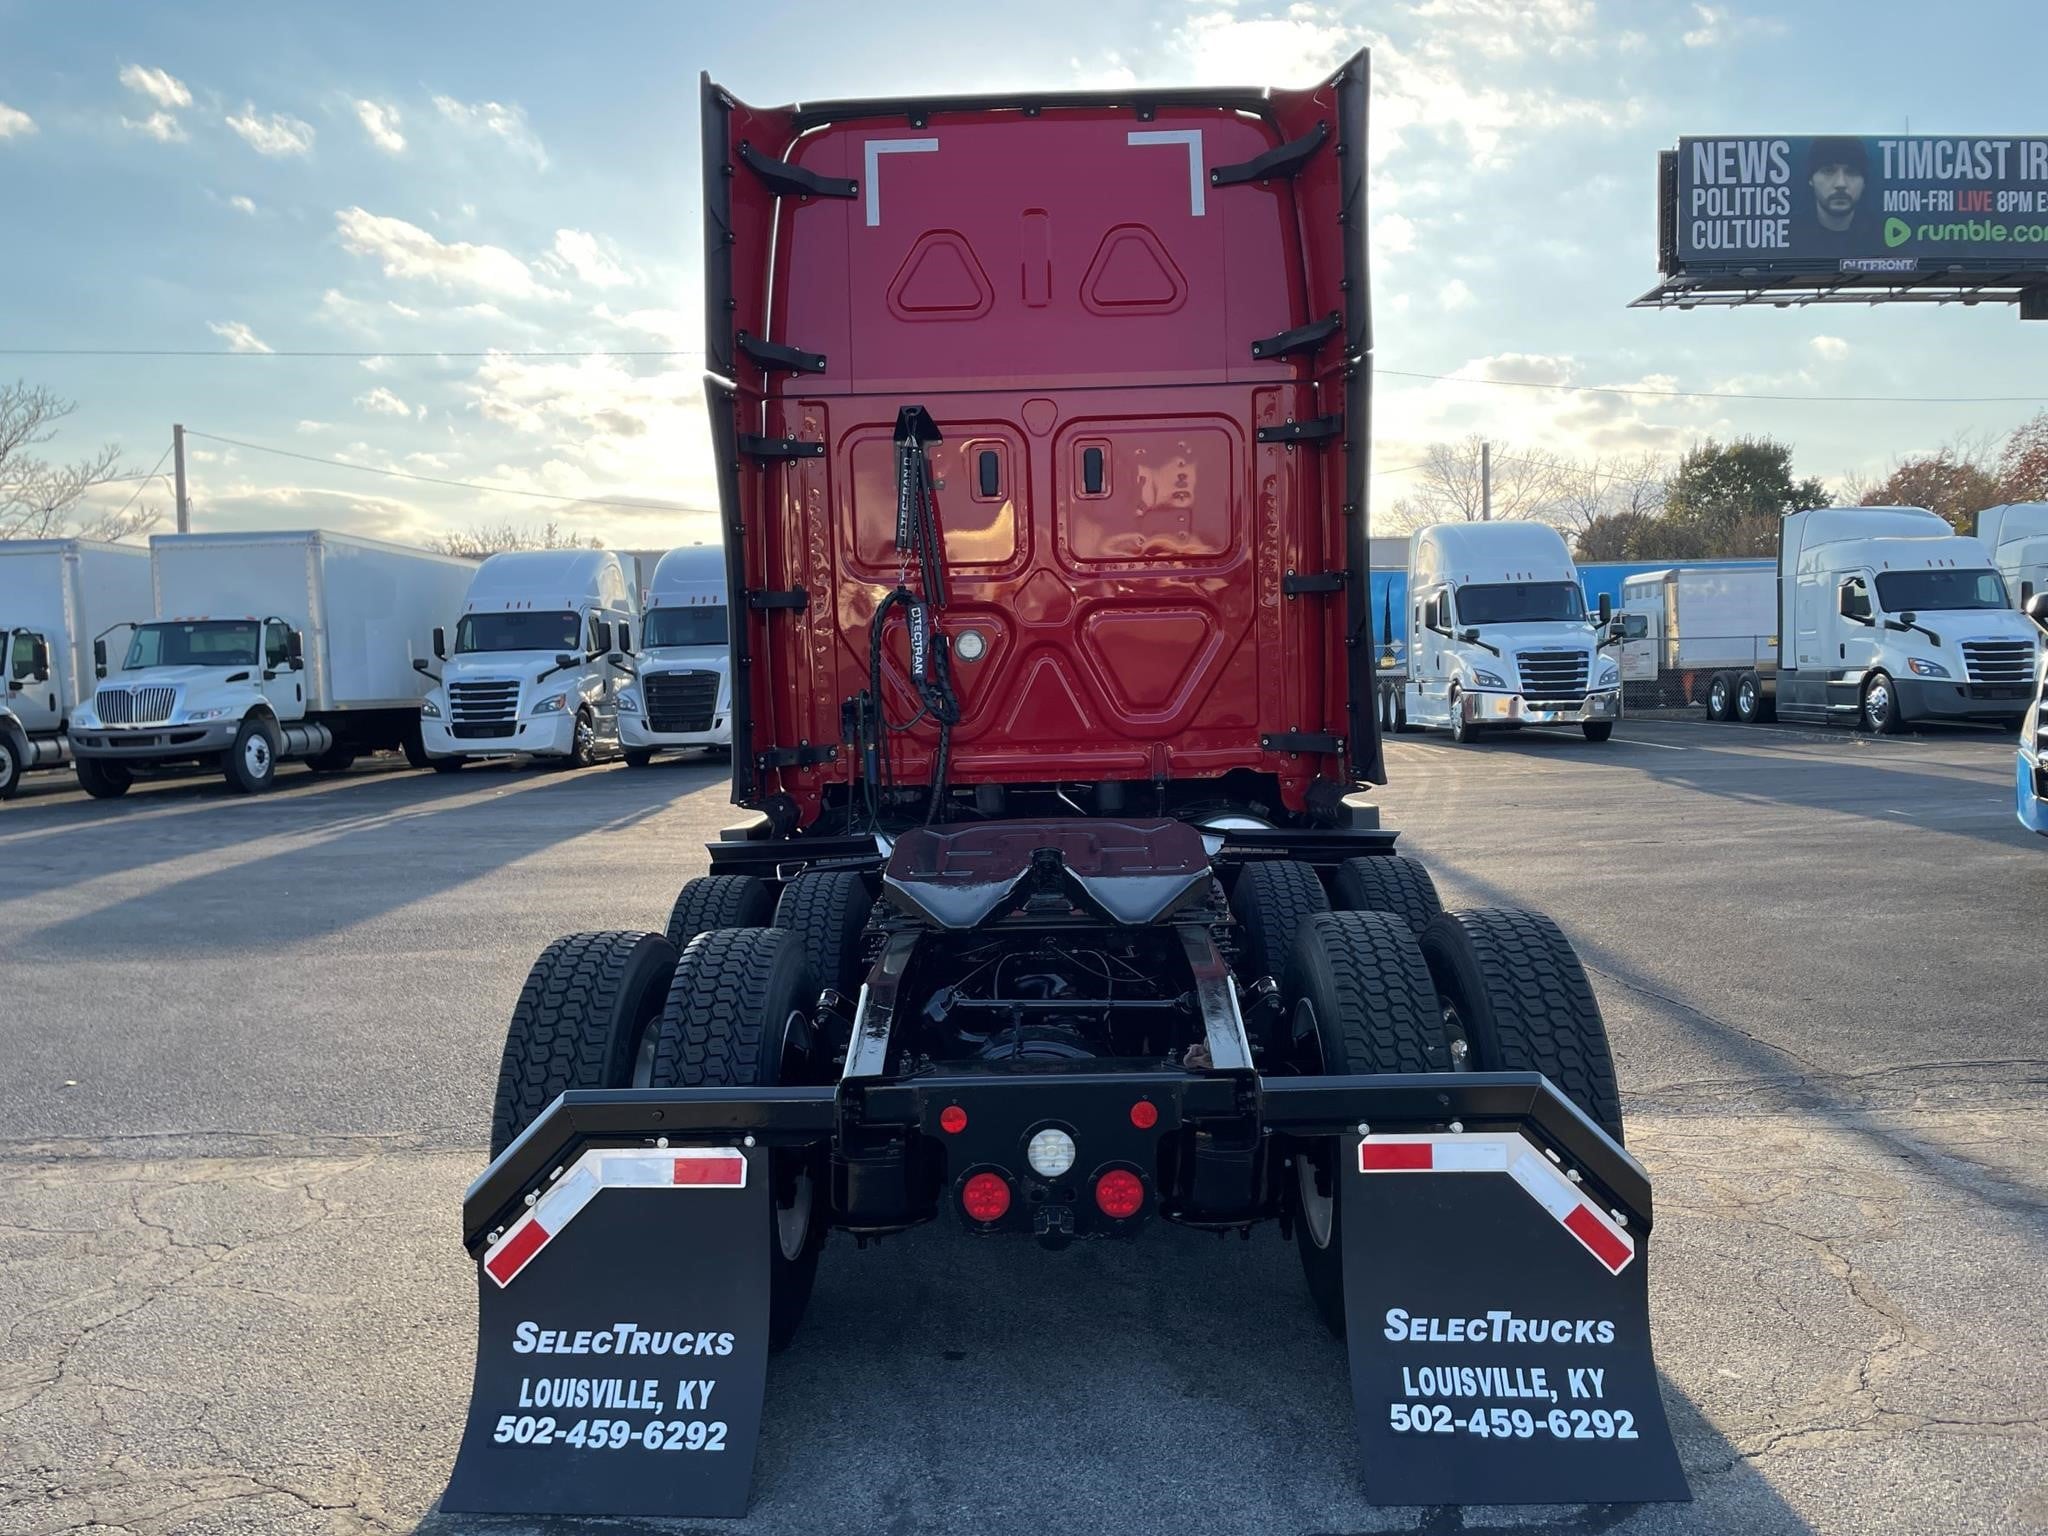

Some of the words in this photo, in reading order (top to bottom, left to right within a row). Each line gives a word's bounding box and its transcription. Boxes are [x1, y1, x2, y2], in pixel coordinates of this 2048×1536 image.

[1692, 141, 1790, 185] NEWS
[1878, 140, 2011, 180] TIMCAST
[1692, 186, 1790, 217] POLITICS
[1883, 190, 1954, 212] MON-FRI
[1957, 190, 1993, 212] LIVE
[1996, 190, 2033, 213] 8PM
[2037, 191, 2048, 213] E
[1692, 218, 1790, 250] CULTURE
[1917, 219, 2048, 243] rumble.co
[913, 616, 924, 675] TECTRAN
[518, 1378, 664, 1415] LOUISVILLE,
[676, 1379, 716, 1410] KY
[1402, 1366, 1558, 1403] LOUISVILLE,
[1567, 1368, 1605, 1399] KY
[493, 1415, 728, 1451] 502-459-6292
[1390, 1403, 1639, 1439] 502-459-6292
